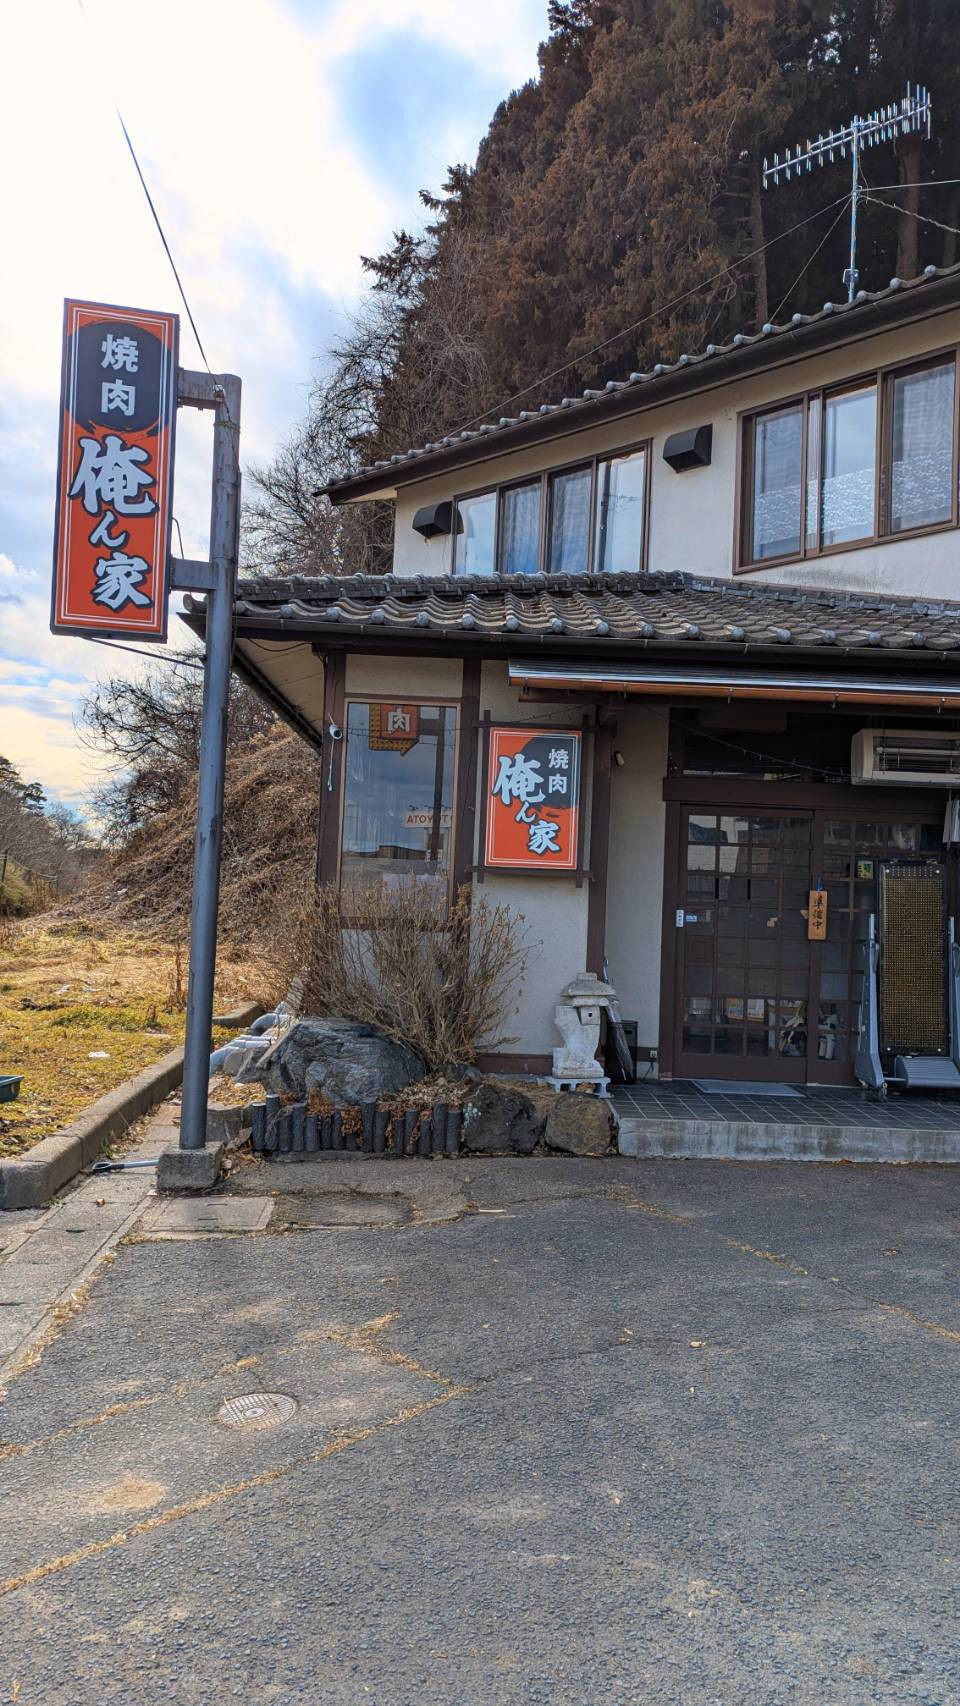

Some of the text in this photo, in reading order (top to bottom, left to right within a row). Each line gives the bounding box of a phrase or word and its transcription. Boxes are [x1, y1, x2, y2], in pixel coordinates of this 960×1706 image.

[101, 334, 139, 417] 焼肉
[69, 434, 158, 609] 俺ん家
[493, 753, 561, 855] 俺ん家
[548, 748, 569, 794] 焼肉
